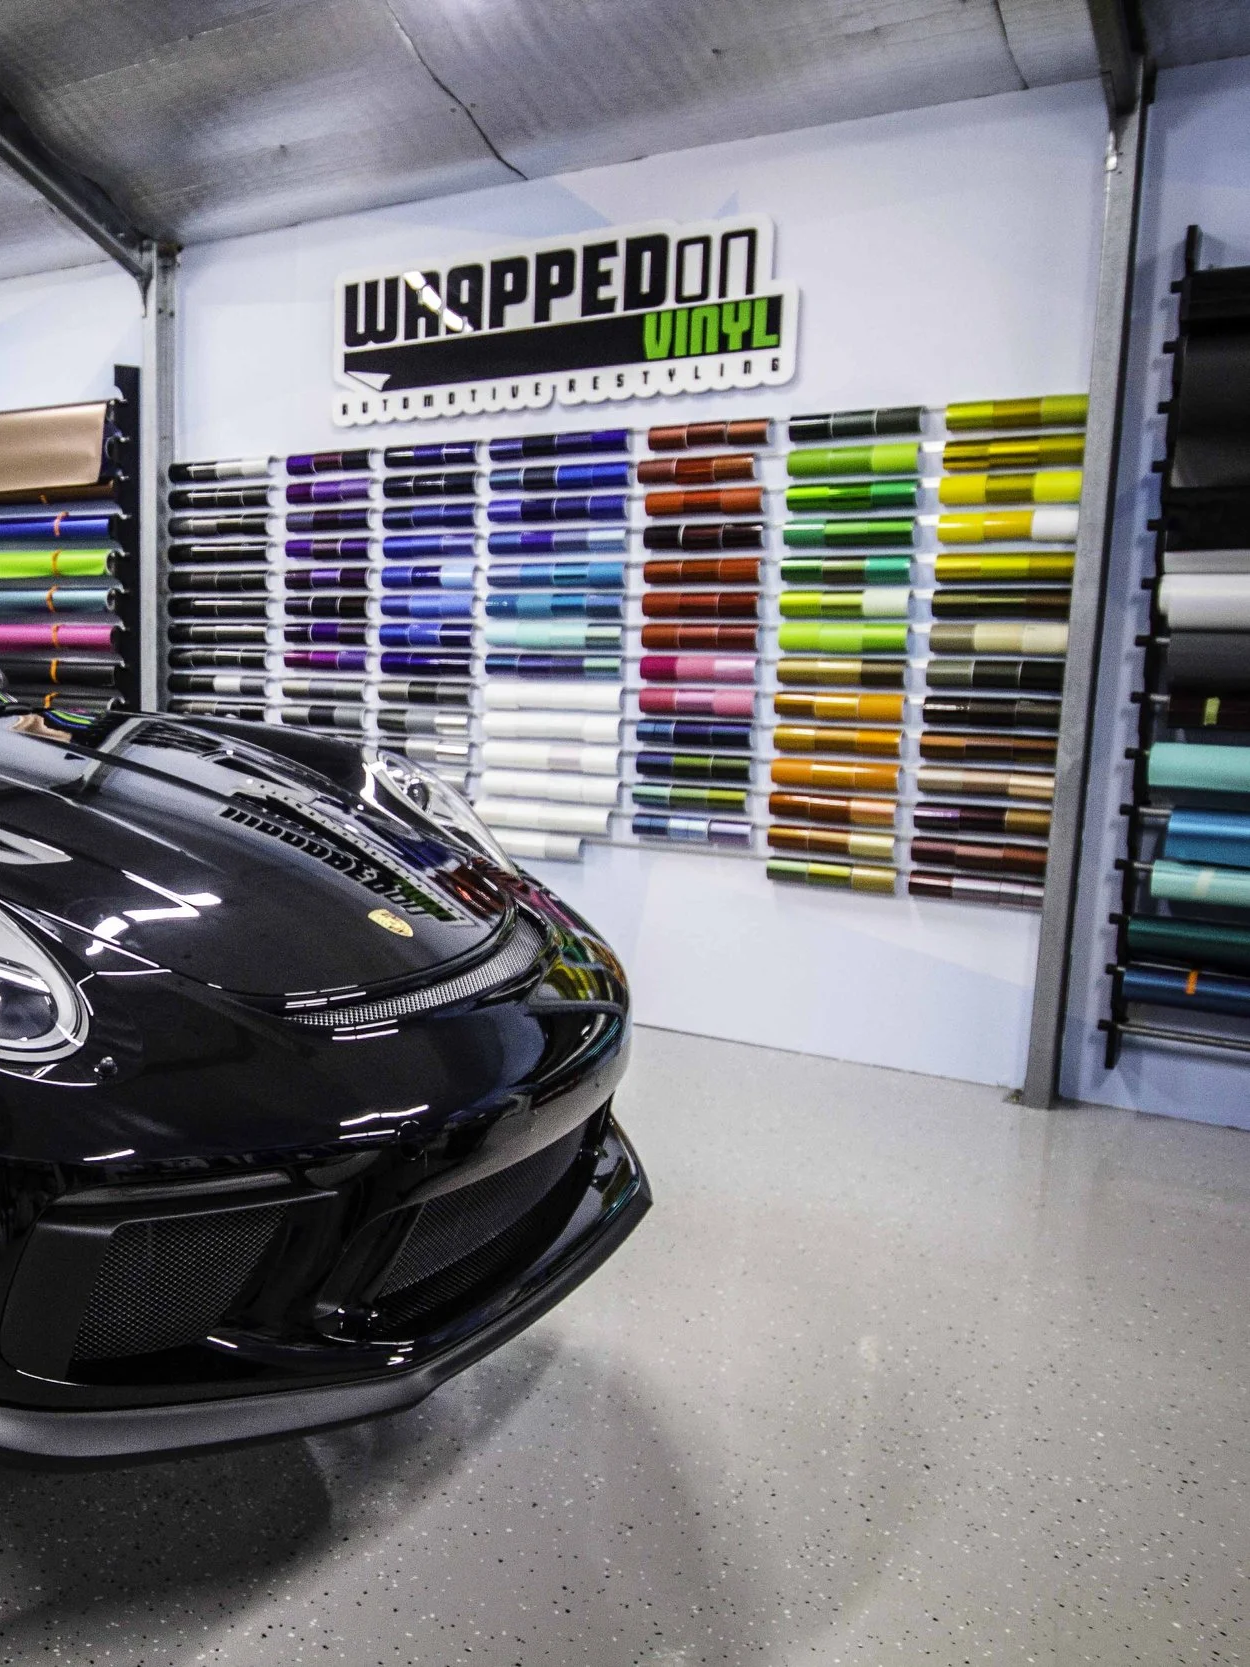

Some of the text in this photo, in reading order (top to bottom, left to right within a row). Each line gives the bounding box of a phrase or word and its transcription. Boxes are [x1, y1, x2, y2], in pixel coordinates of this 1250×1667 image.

[643, 298, 780, 360] VINYL
[341, 357, 780, 416] AUTOMOTIVE RESTYLING
